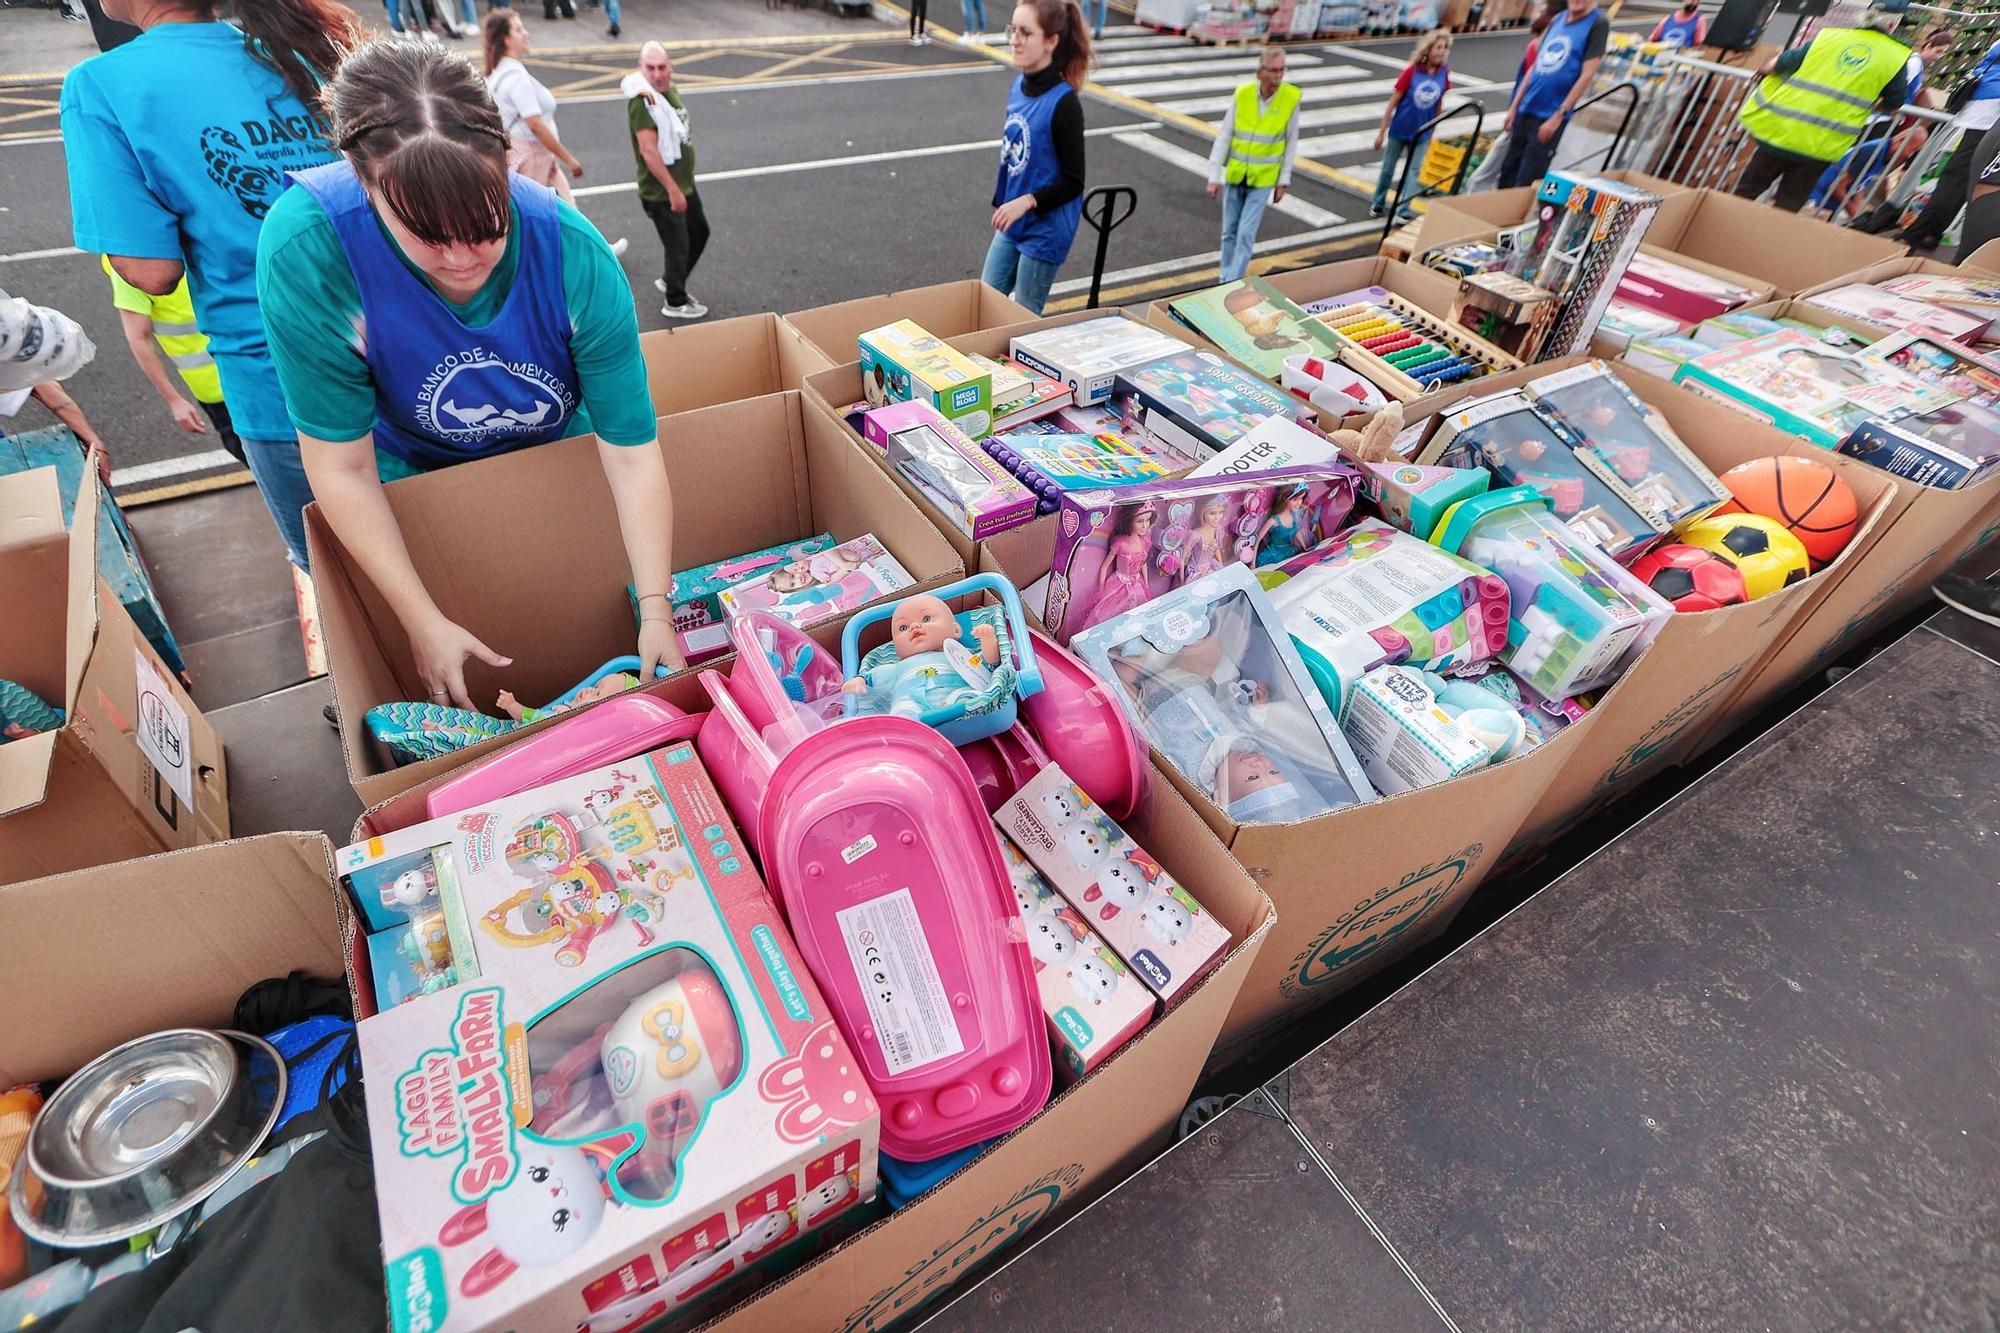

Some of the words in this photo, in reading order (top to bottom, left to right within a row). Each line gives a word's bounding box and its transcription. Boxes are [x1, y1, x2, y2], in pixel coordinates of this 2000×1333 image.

[418, 354, 459, 401] BANCO
[460, 347, 486, 363] DE
[955, 388, 977, 400] MEGA
[956, 396, 978, 408] BLOKS
[971, 453, 1021, 493] pulseras
[1006, 507, 1034, 522] pulseras
[1642, 509, 1663, 527] DIY
[1016, 801, 1044, 833] CLEANERS
[1016, 823, 1031, 843] LAGU
[1019, 818, 1037, 842] FAMILY
[1038, 833, 1054, 850] DRY
[1294, 887, 1390, 961] BANCOS
[1400, 863, 1434, 885] DE
[1343, 880, 1444, 939] FESBAL
[755, 928, 783, 970] together!
[788, 990, 806, 1016] Let's
[457, 993, 497, 1080] FARM
[405, 1076, 432, 1148] LAGU
[427, 1057, 457, 1147] FAMILY
[461, 1071, 509, 1194] SMALL
[865, 1207, 1043, 1328] FESBAL
